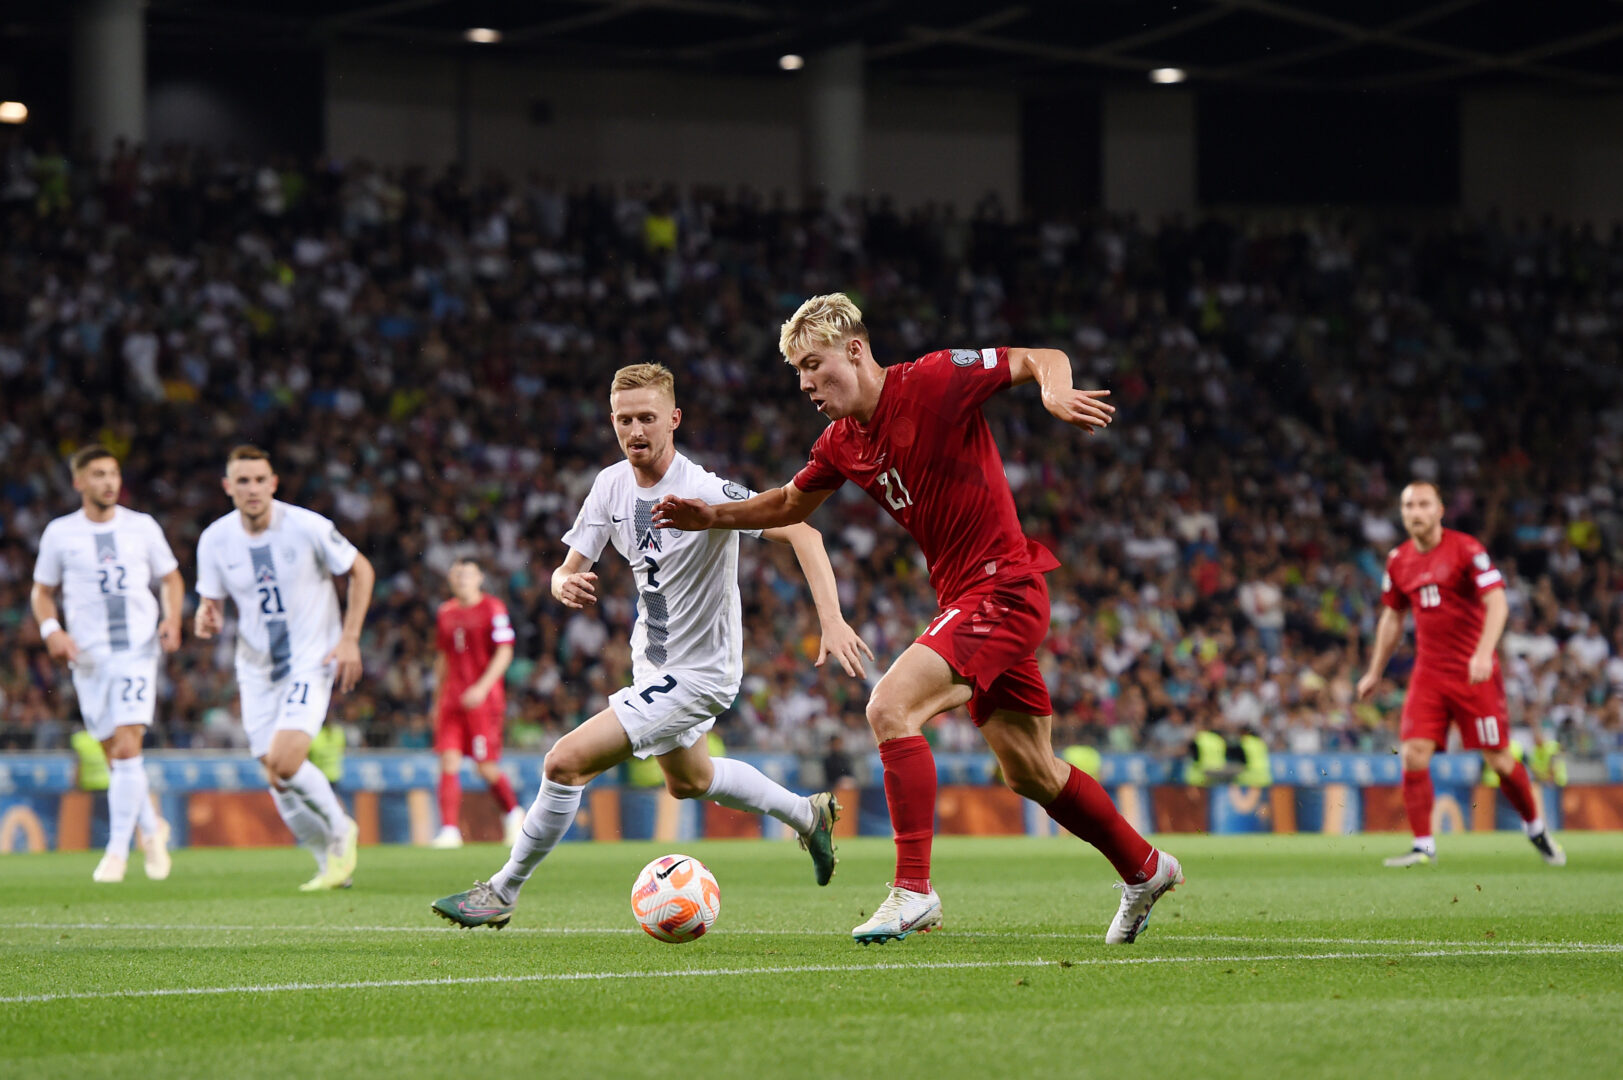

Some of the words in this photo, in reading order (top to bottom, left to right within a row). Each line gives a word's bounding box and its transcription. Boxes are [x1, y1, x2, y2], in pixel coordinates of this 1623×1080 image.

[876, 467, 913, 511] 21
[98, 566, 126, 593] 22
[645, 555, 660, 588] 2
[259, 587, 285, 614] 21
[122, 677, 146, 701] 22
[287, 682, 309, 704] 21
[639, 674, 678, 704] 2
[1475, 715, 1500, 746] 10
